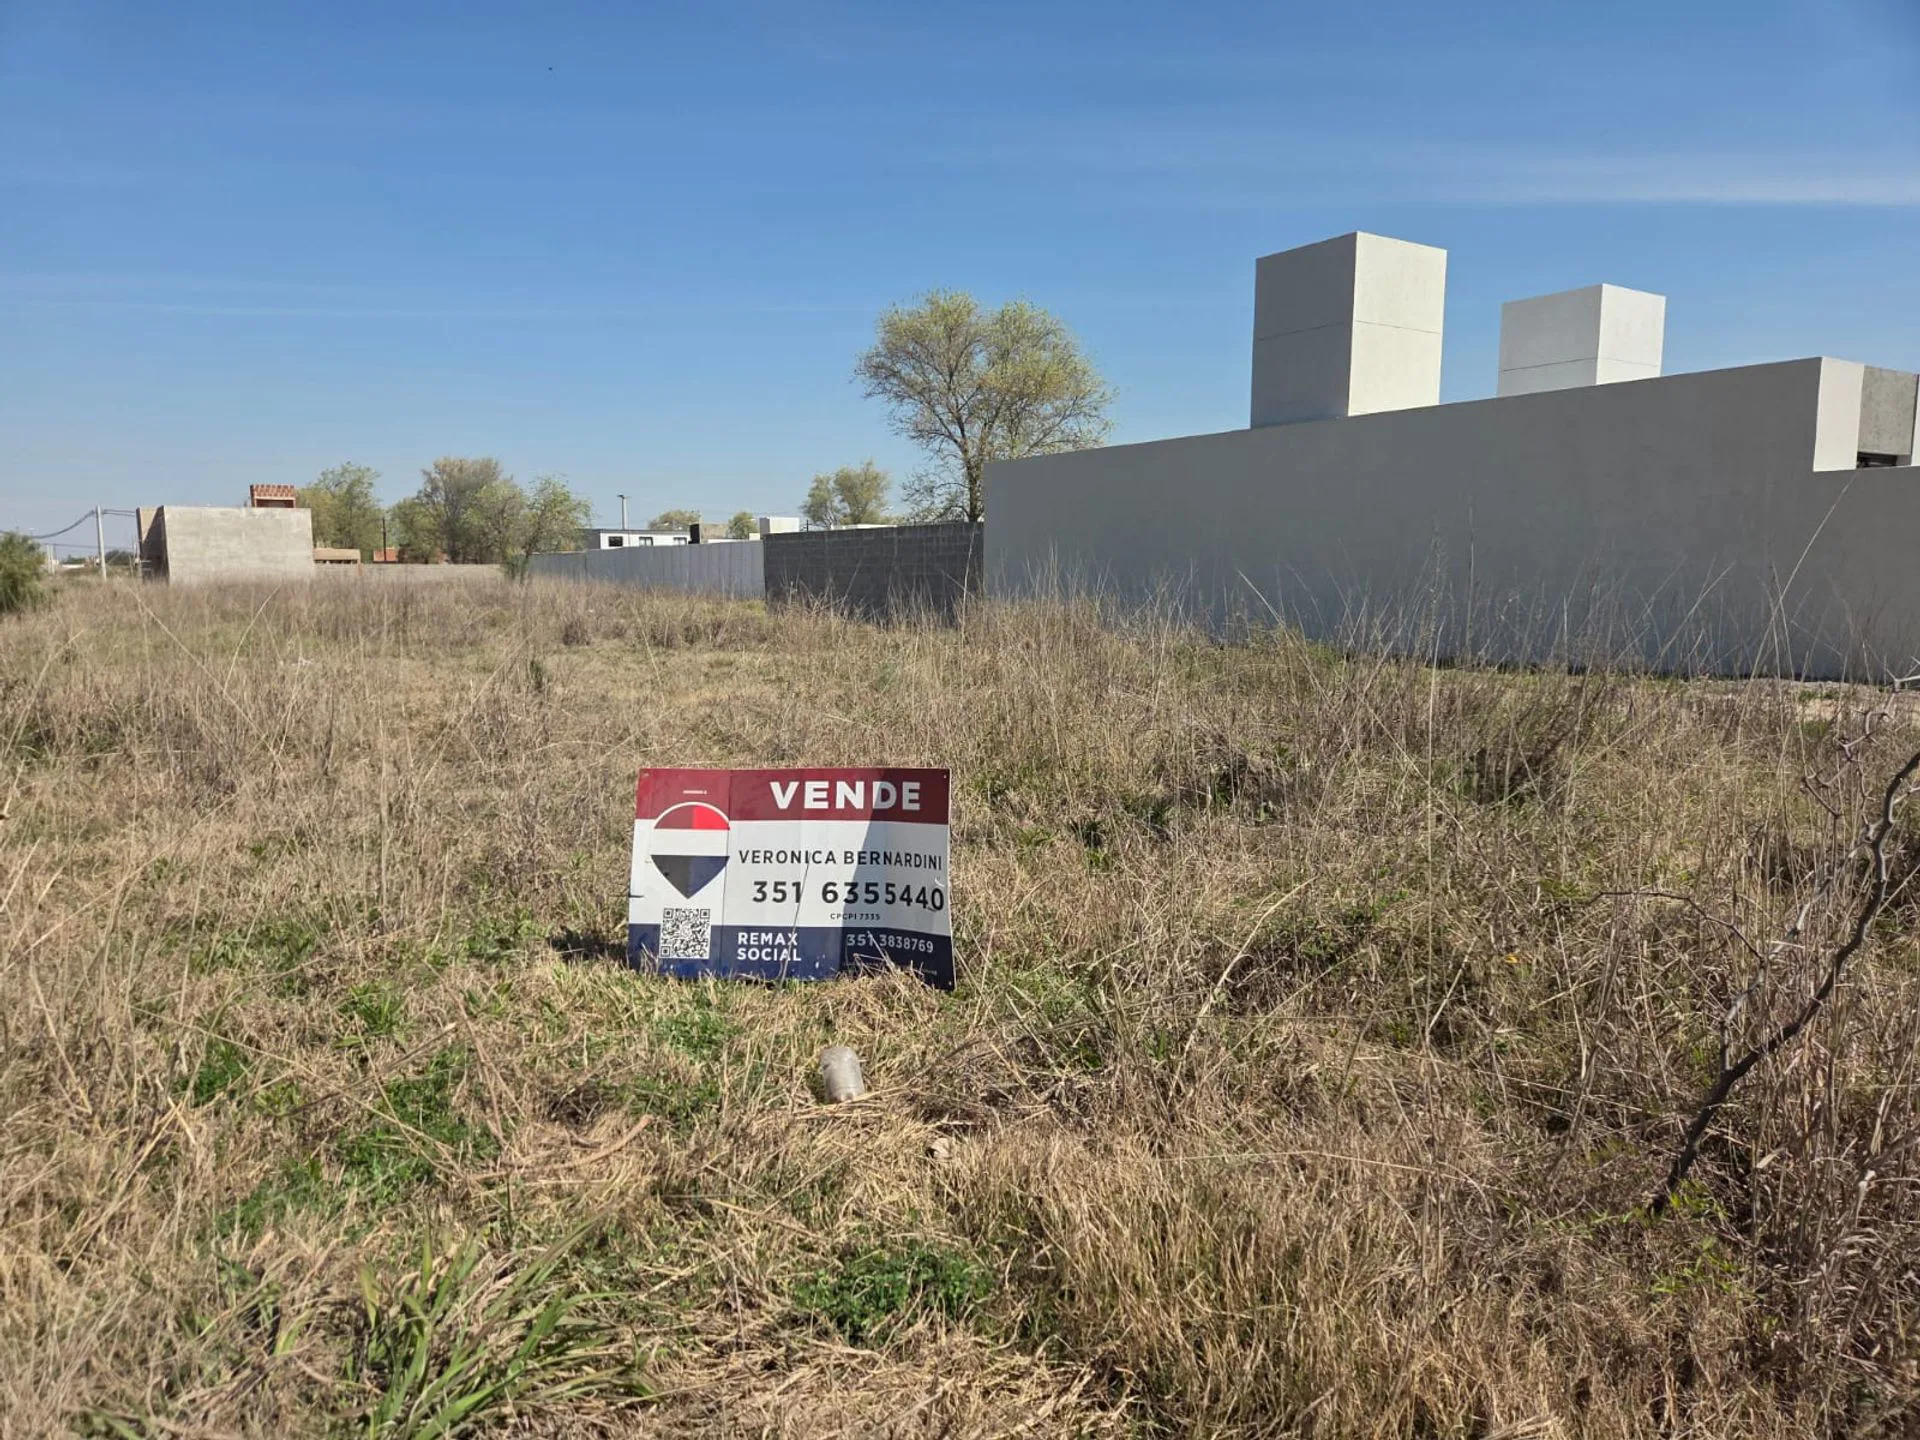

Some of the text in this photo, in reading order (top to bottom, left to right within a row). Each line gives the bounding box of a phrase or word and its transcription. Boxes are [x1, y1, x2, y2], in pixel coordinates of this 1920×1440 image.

[770, 781, 921, 811] VENDE
[739, 849, 943, 870] VERONICA BERNARDINI
[752, 881, 945, 911] 351 6355440
[738, 932, 798, 945] REMAX
[878, 934, 934, 953] 3838769
[737, 948, 802, 961] SOCIAL
